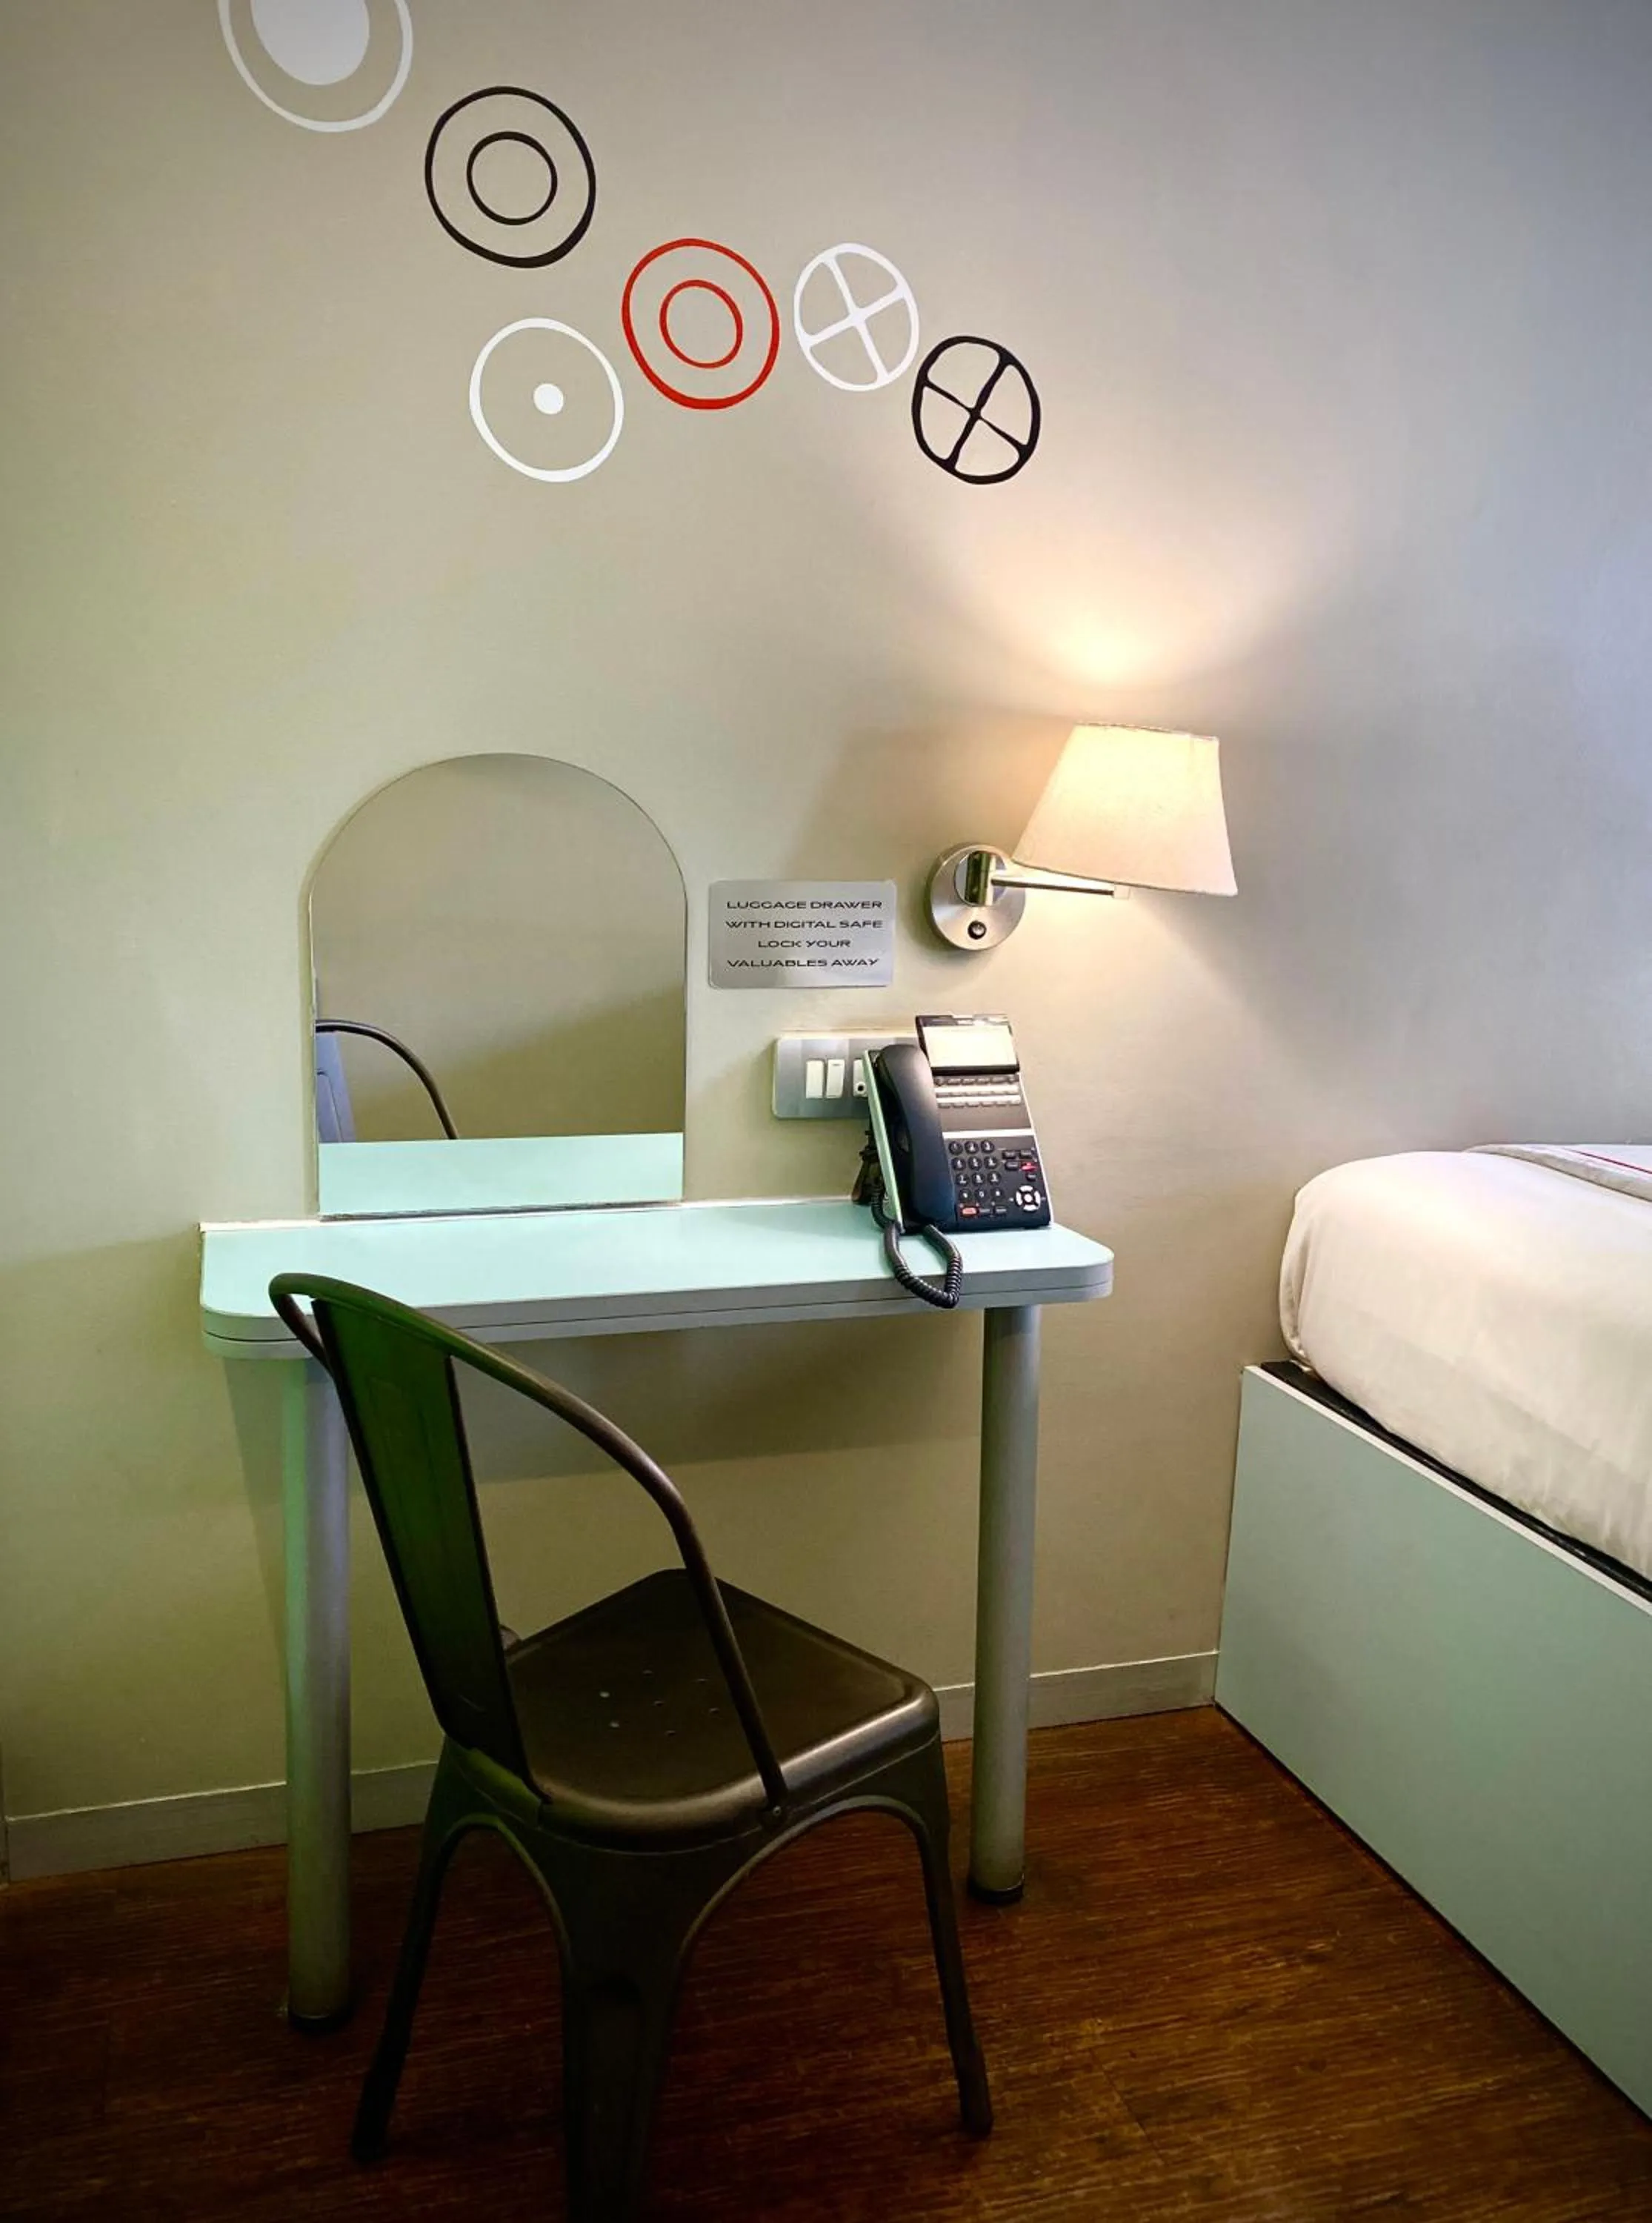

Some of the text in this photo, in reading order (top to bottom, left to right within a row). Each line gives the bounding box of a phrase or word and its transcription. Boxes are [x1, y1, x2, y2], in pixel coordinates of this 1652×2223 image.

[726, 900, 882, 909] LUGGAGE DRAWER
[725, 920, 883, 929] WITH DIGITAL SAFE
[758, 940, 851, 948] LOCK YOUR
[727, 958, 879, 968] VALUABLES AWAY
